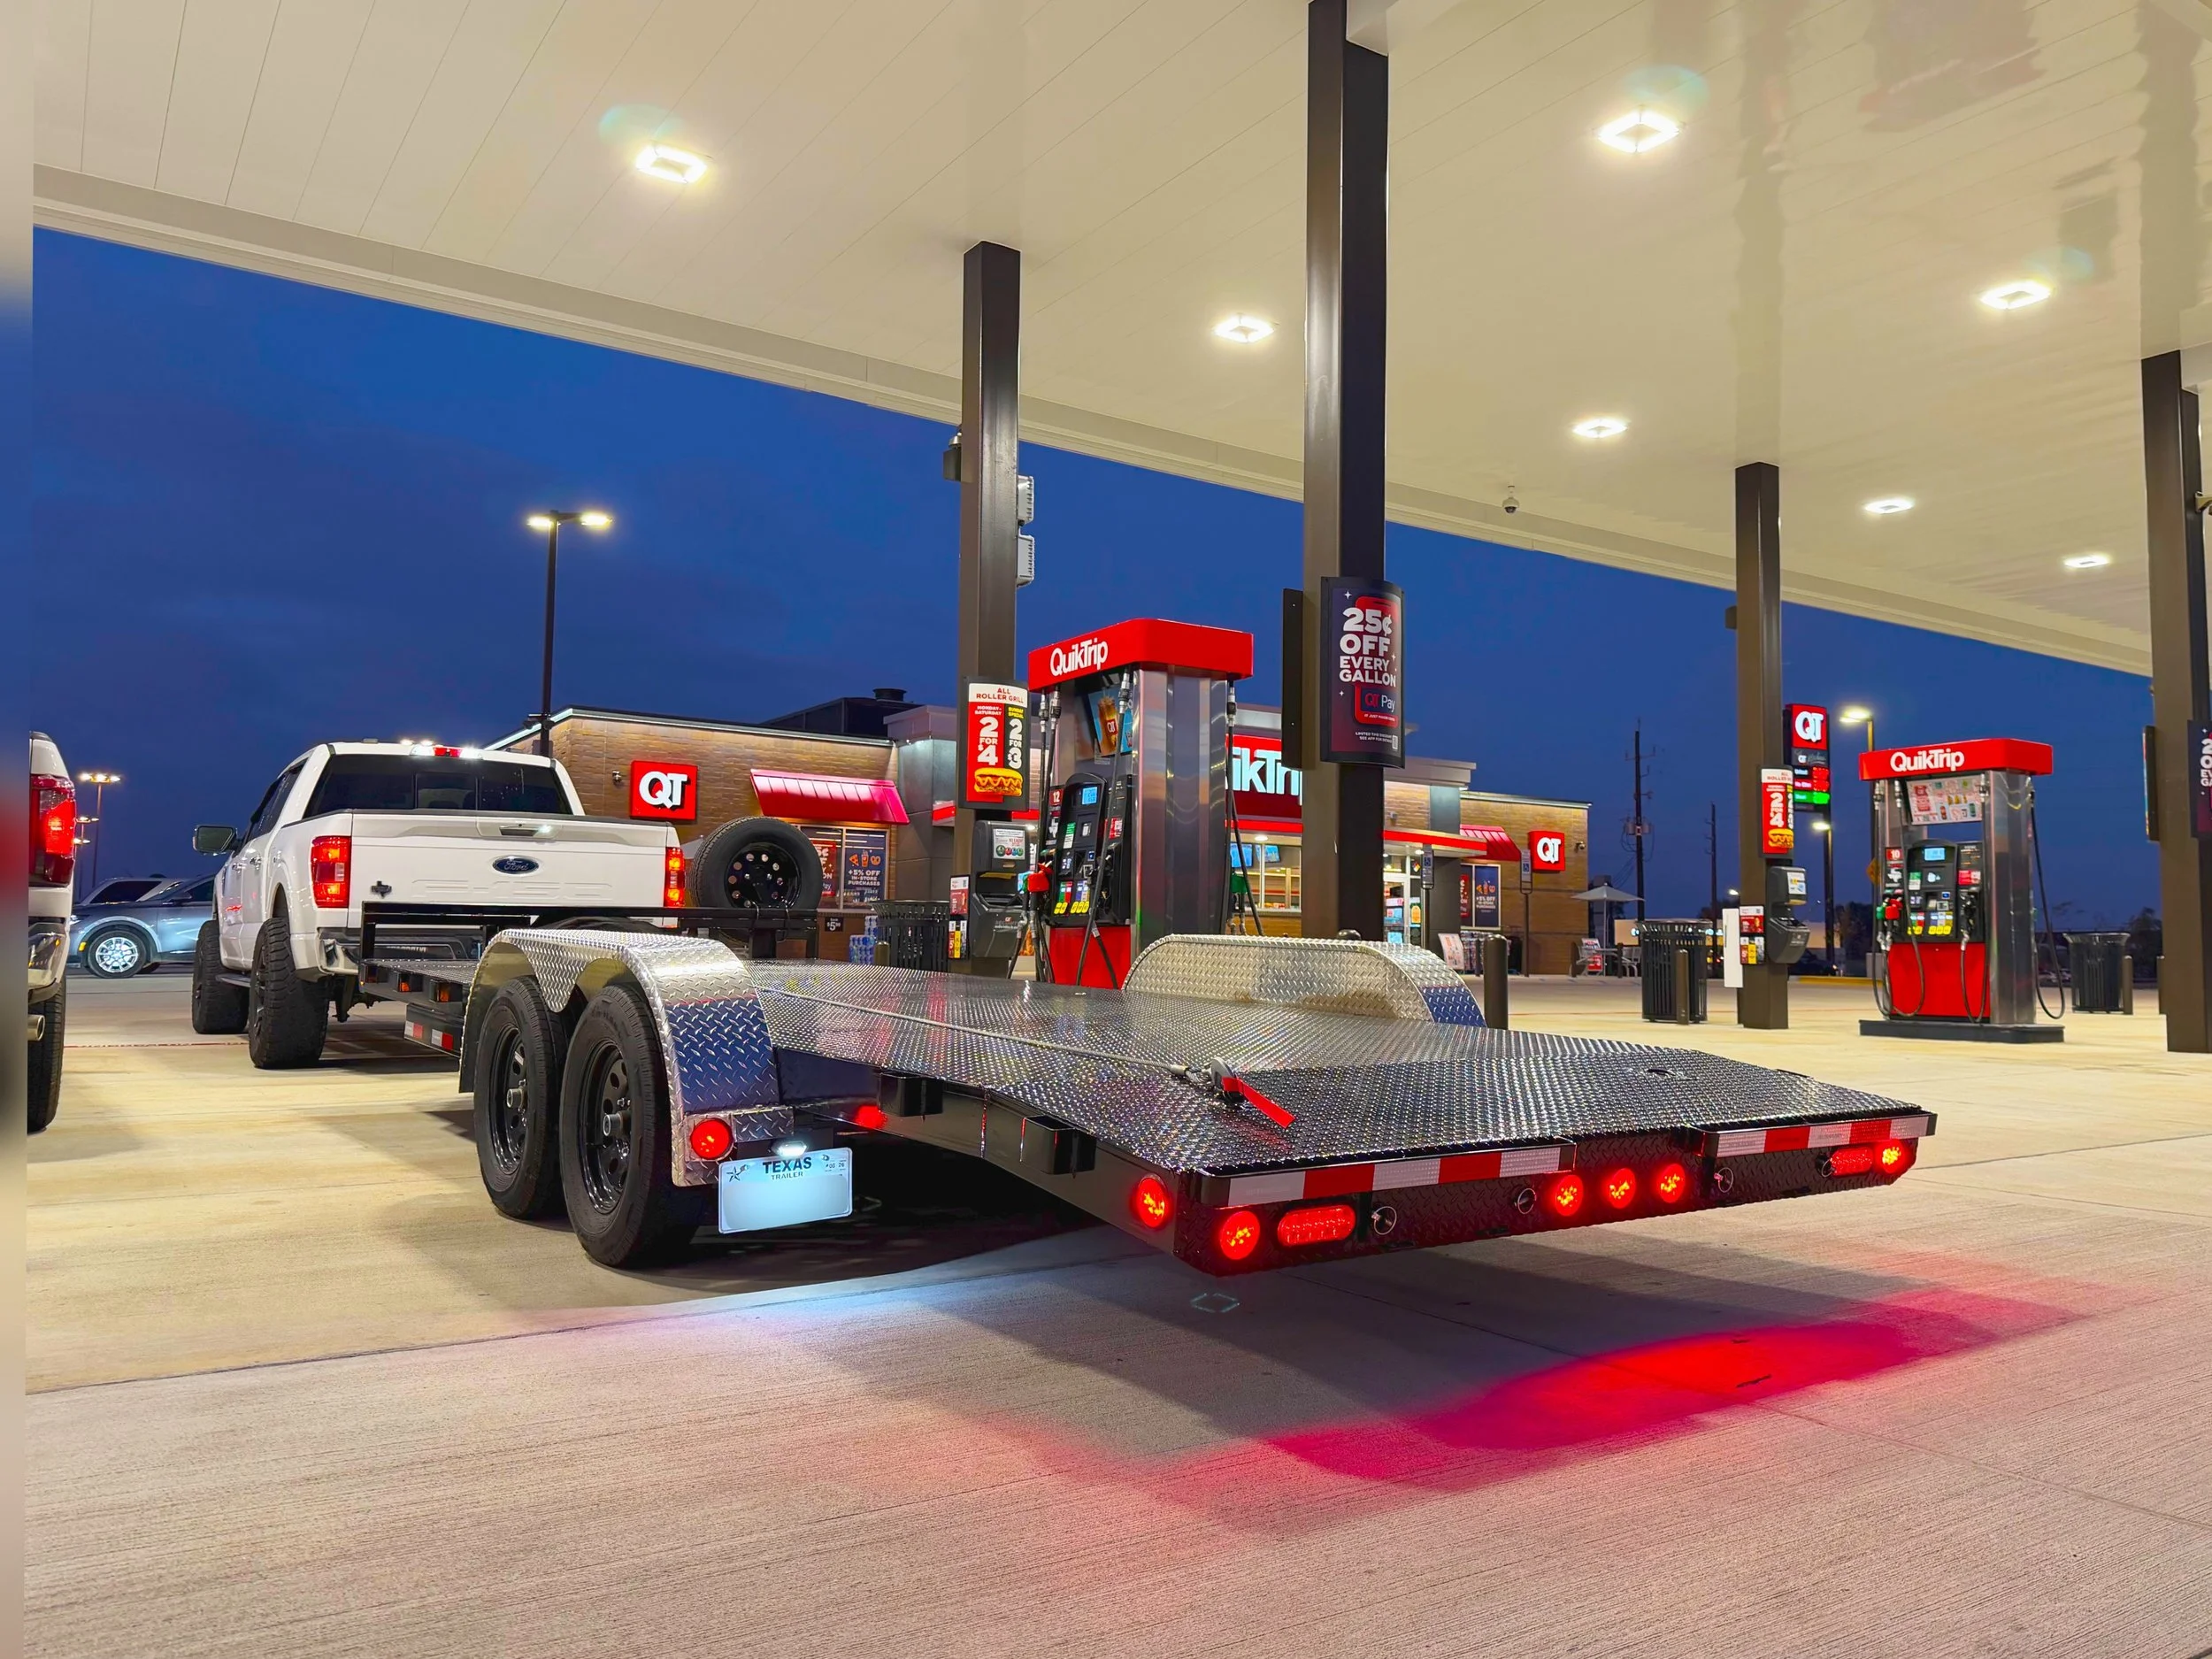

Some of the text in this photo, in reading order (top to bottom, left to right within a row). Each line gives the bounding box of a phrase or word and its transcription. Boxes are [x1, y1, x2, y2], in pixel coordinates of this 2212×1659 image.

[1342, 607, 1392, 636] 25¢
[1340, 634, 1390, 657] OFF
[1050, 638, 1108, 677] QuikTrip
[1340, 656, 1389, 672] EVERY
[1339, 669, 1396, 687] GALLON
[1364, 693, 1395, 712] QT Pay
[979, 717, 998, 738] 2
[1010, 718, 1022, 741] 2
[1795, 711, 1824, 742] QT
[978, 745, 998, 765] $4
[1890, 749, 1964, 772] QuikTrip
[639, 771, 687, 809] QT
[1052, 790, 1060, 803] 12
[1770, 792, 1784, 808] 2
[1537, 837, 1561, 864] QT
[1891, 850, 1900, 860] 10
[503, 860, 529, 871] Ford
[762, 1156, 812, 1173] TEXAS
[771, 1171, 803, 1180] TRAILER
